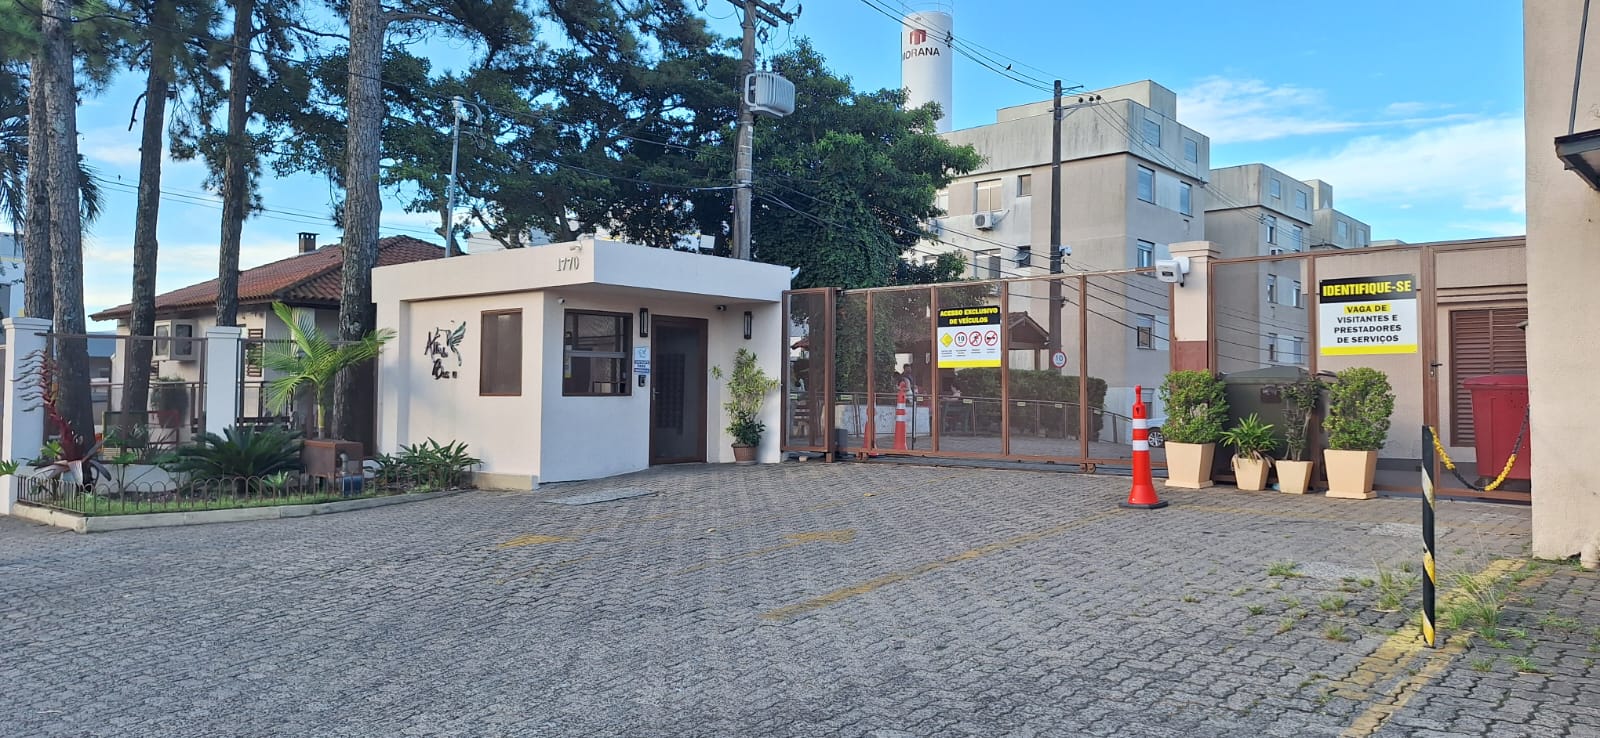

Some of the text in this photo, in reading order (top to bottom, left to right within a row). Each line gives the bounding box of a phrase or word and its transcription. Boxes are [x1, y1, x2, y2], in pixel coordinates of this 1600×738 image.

[556, 256, 580, 271] 1770
[1322, 279, 1412, 297] IDENTIFIQUE-SE
[940, 307, 998, 317] ACESSO EXCLUSIVO
[1346, 304, 1388, 313] VAGA DE
[1336, 314, 1390, 323] VISITANTES
[1333, 324, 1402, 334] PRESTADORES
[1336, 334, 1399, 344] DE SERVIÇOS
[1055, 354, 1064, 362] 10
